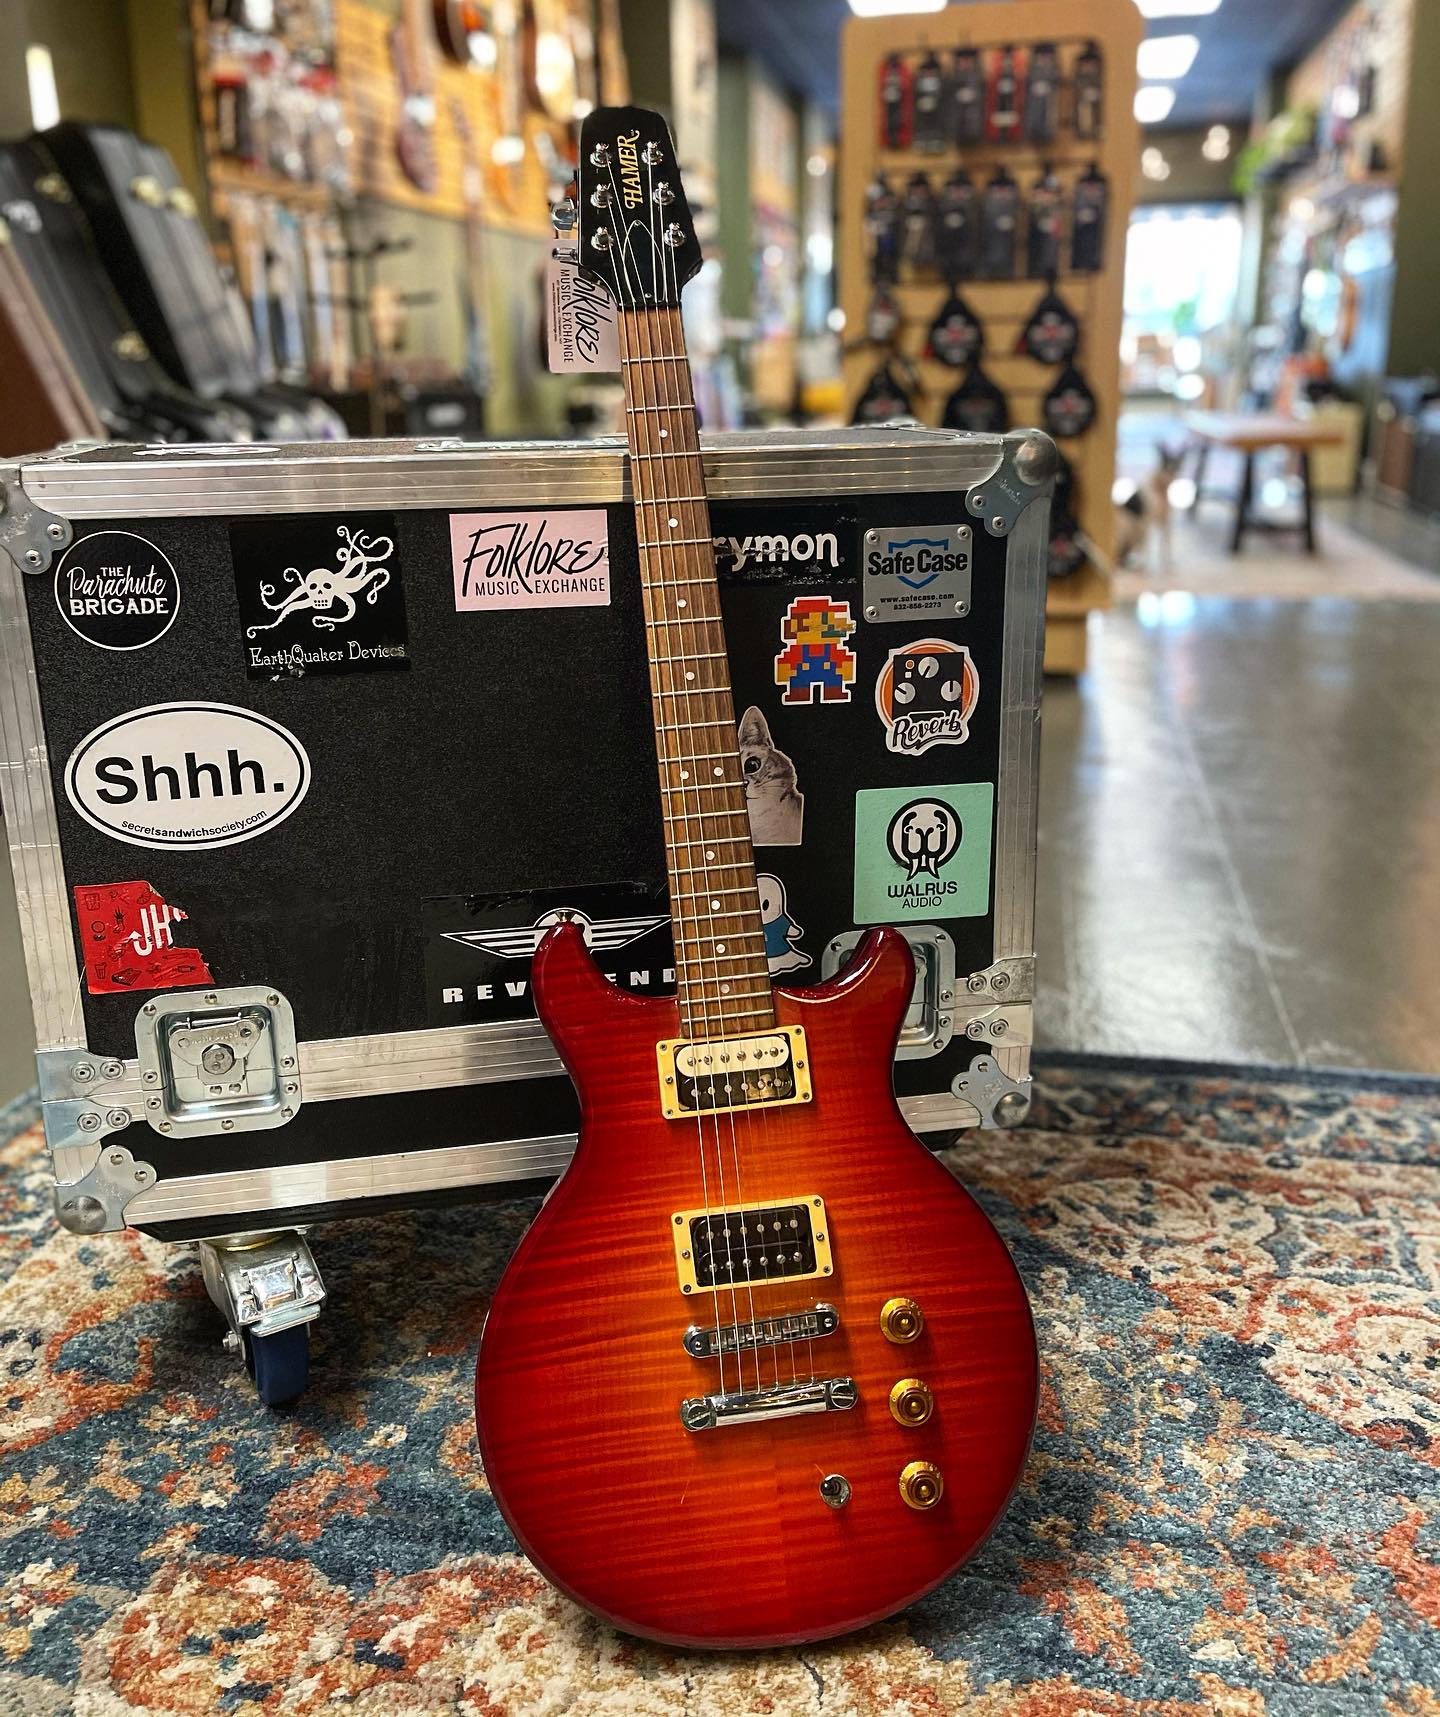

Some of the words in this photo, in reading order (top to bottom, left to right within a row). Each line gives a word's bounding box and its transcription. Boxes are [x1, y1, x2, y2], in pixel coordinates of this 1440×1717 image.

[617, 129, 644, 210] HAMER
[560, 269, 571, 301] MUSIC
[562, 312, 574, 363] EXCHANGE
[66, 564, 168, 599] Parachute
[100, 566, 125, 577] THE
[475, 580, 519, 596] MUSIC
[534, 577, 606, 594] EXCHANGE
[69, 597, 169, 616] BRIGADE
[249, 644, 344, 669] EarthQuaker
[892, 710, 962, 750] Reverb
[95, 749, 285, 805] Shhh.
[121, 808, 268, 839] secretsandwichsociety.com
[887, 881, 958, 898] WALRUS
[902, 896, 942, 909] AUDIO
